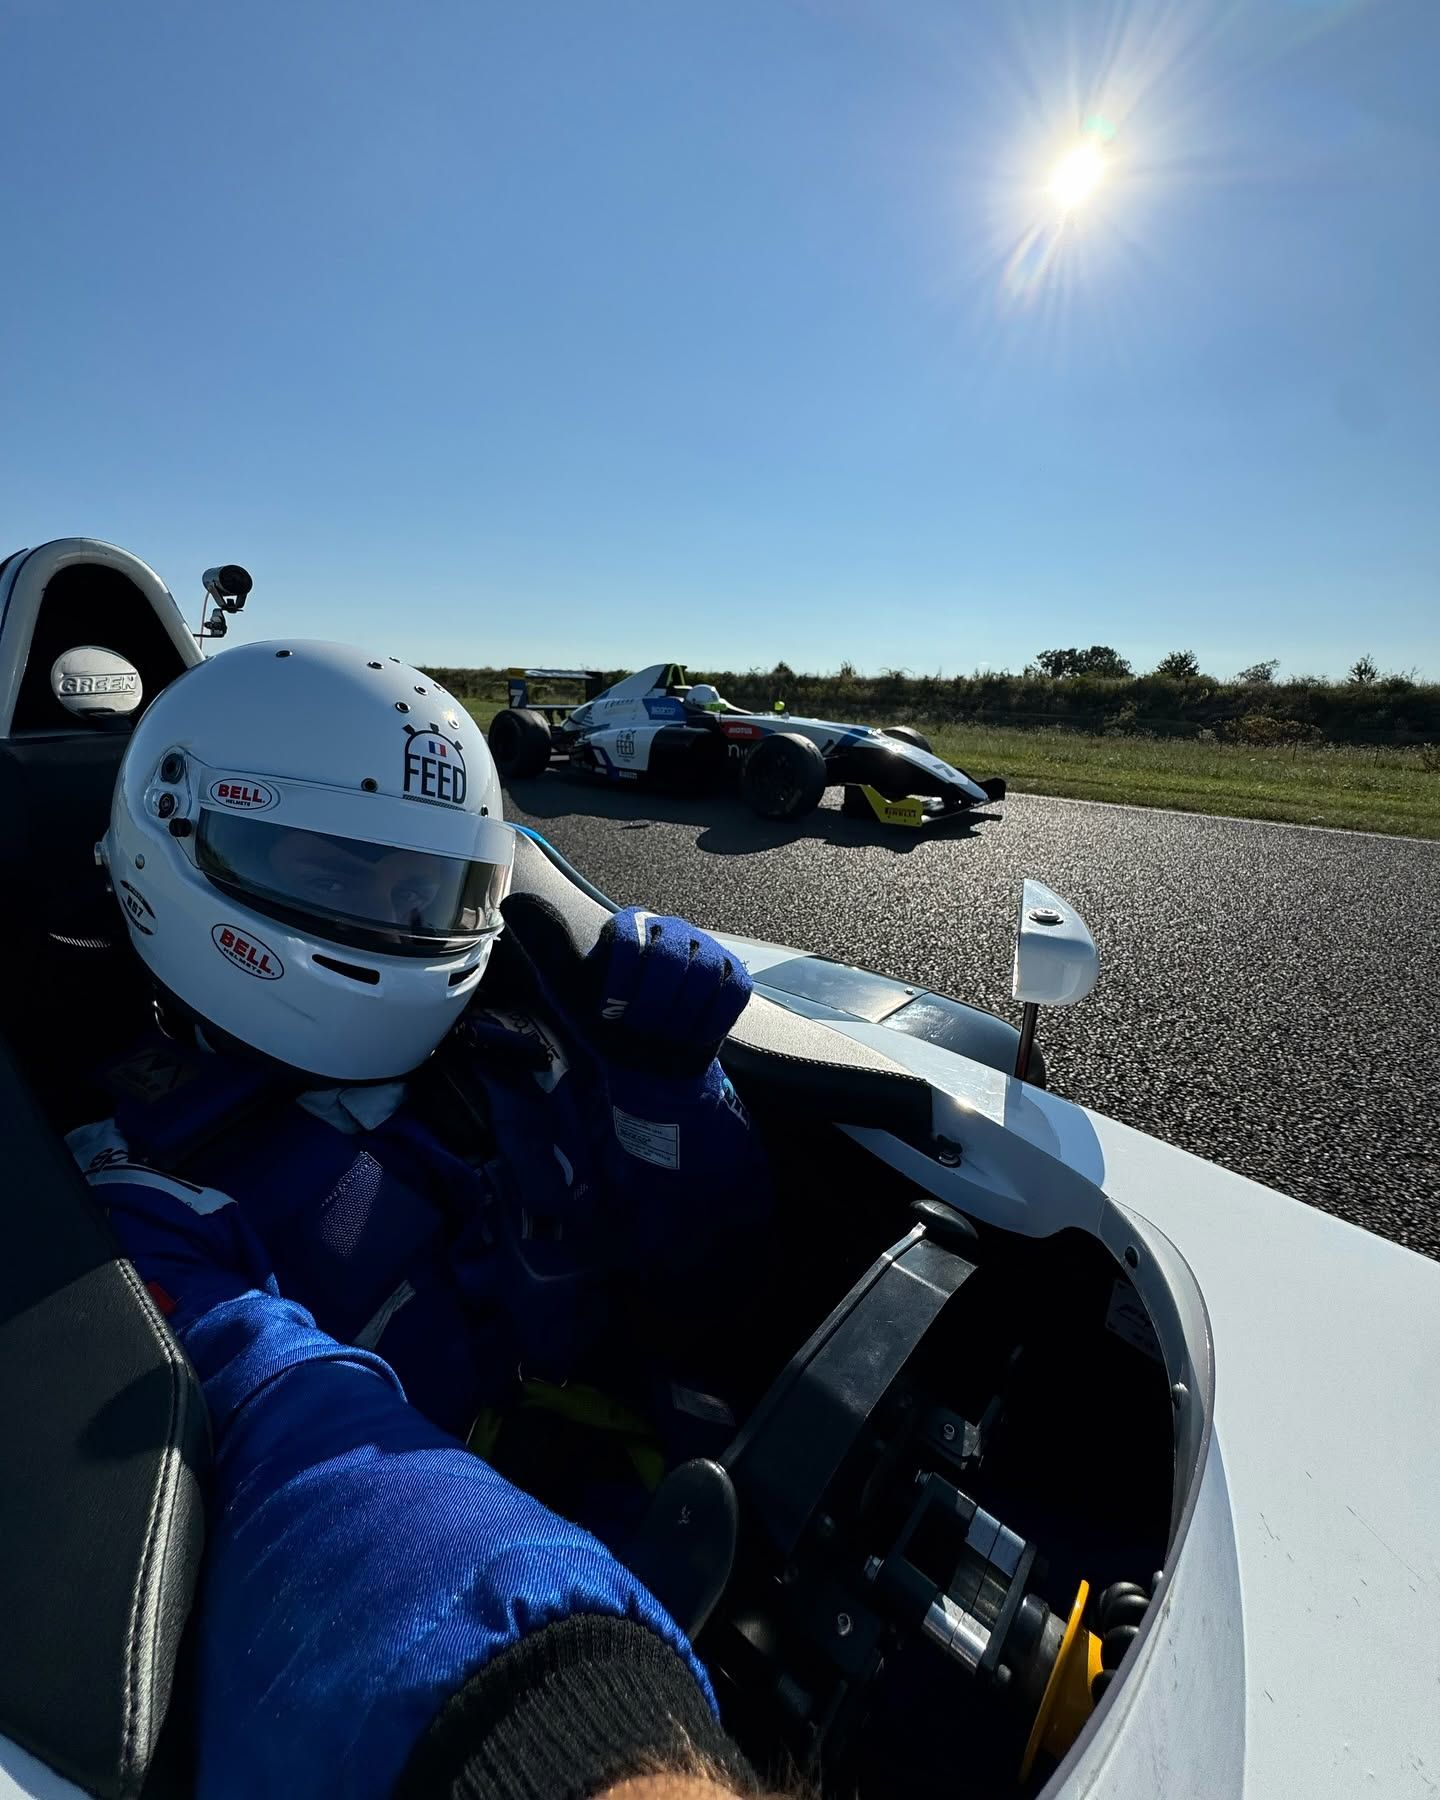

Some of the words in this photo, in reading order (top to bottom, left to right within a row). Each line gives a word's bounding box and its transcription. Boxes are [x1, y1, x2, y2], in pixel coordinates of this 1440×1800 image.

[61, 675, 137, 694] GREEN
[509, 689, 525, 707] 7
[616, 740, 635, 756] FEED
[403, 753, 467, 804] FEED
[933, 763, 956, 778] 7
[218, 783, 263, 804] BELL
[225, 798, 251, 807] HELMETS
[219, 927, 273, 975] BELL
[223, 946, 262, 975] HELMETS
